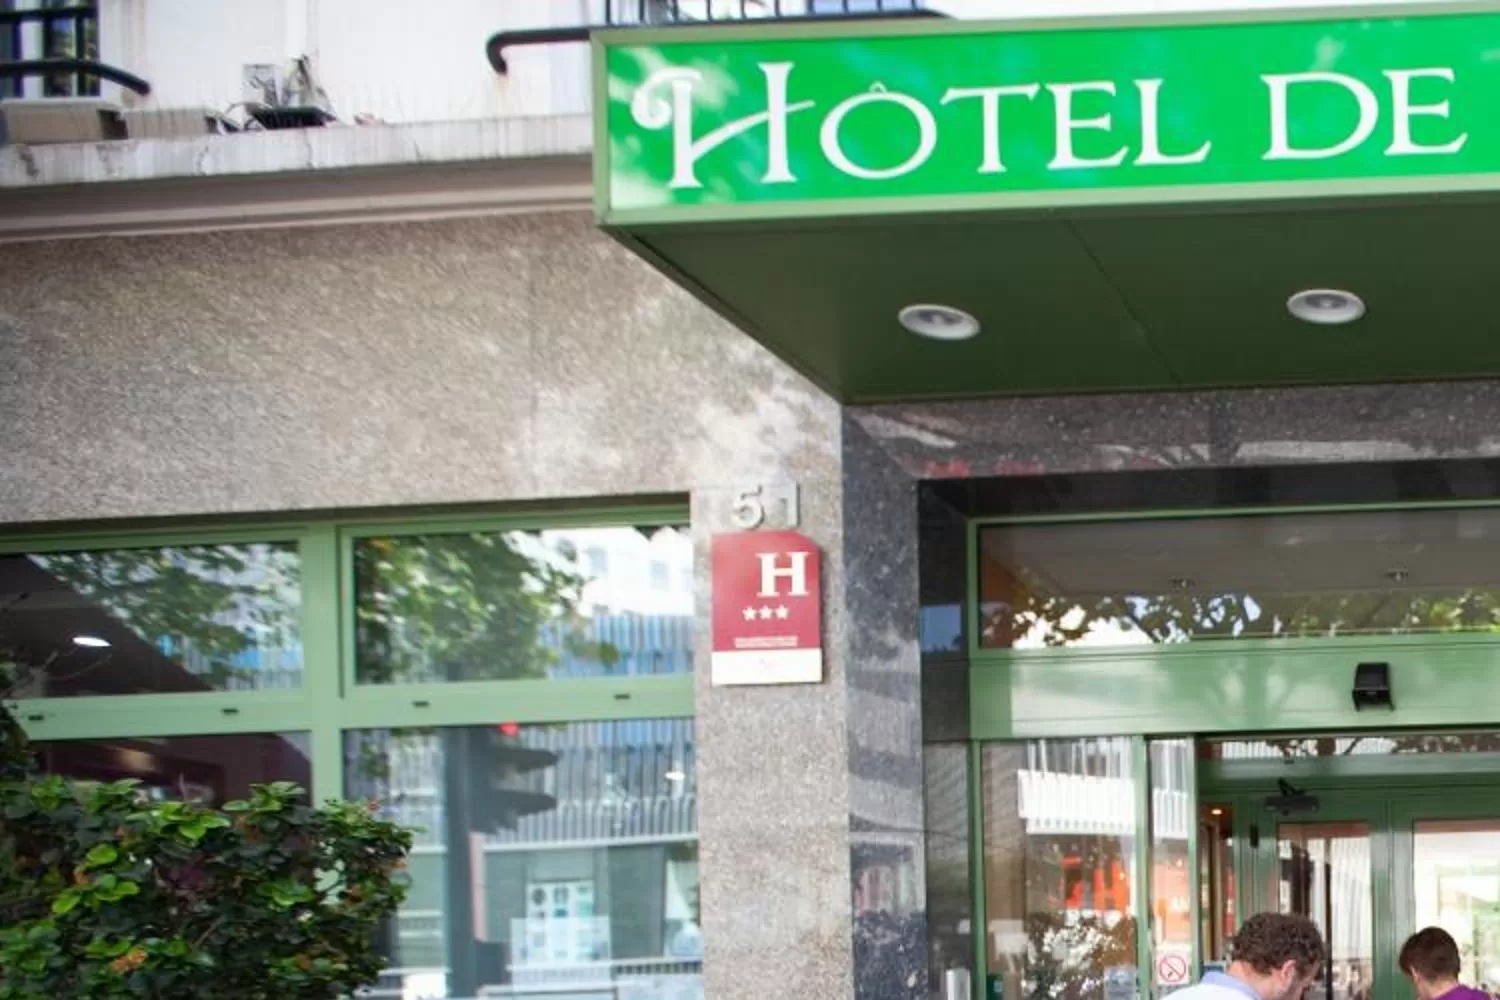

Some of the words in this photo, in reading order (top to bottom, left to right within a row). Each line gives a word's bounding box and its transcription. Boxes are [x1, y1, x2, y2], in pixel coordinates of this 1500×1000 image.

[630, 60, 1212, 190] HÔTEL
[1259, 66, 1469, 161] DE
[731, 479, 801, 530] 51
[756, 550, 810, 598] H
